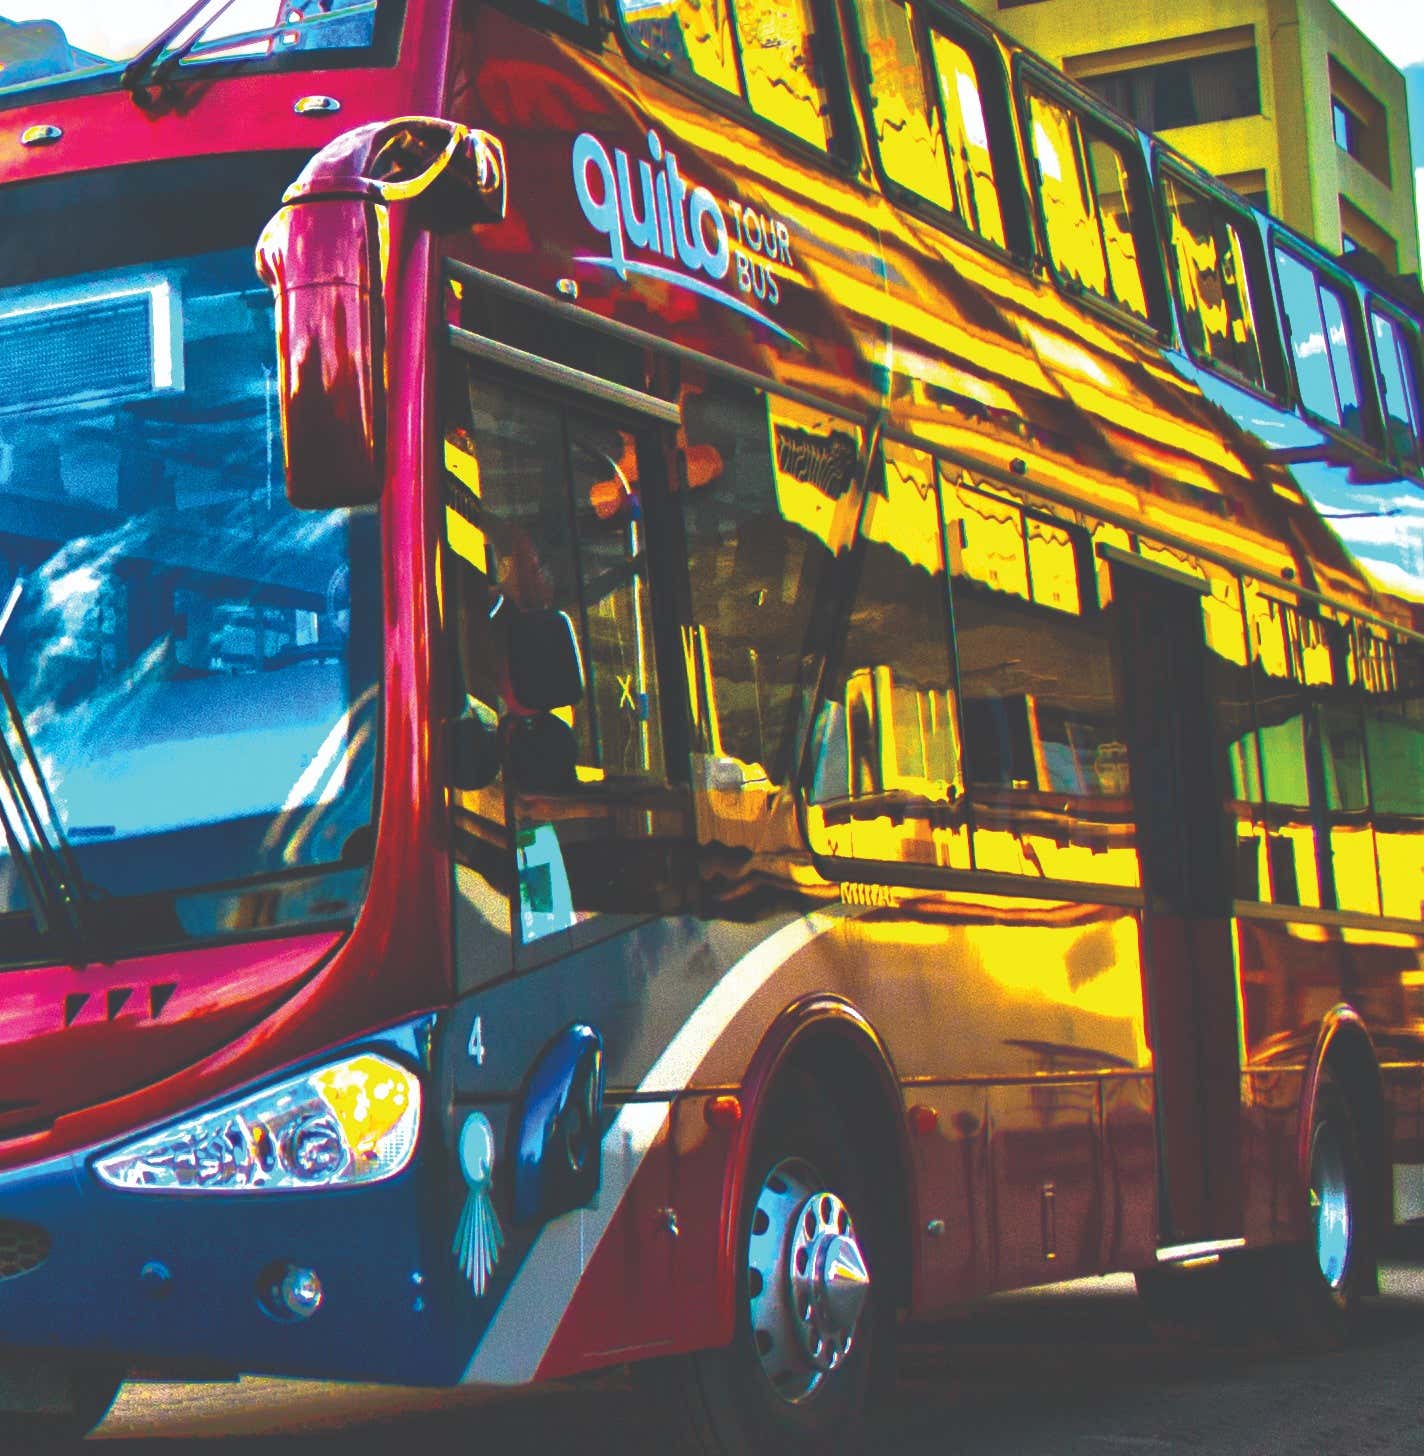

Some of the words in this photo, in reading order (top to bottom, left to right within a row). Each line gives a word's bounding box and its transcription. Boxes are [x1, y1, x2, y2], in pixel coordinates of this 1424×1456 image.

[572, 129, 729, 281] quito
[729, 199, 793, 266] TOUR
[735, 250, 779, 304] BUS
[468, 1015, 485, 1065] 4
